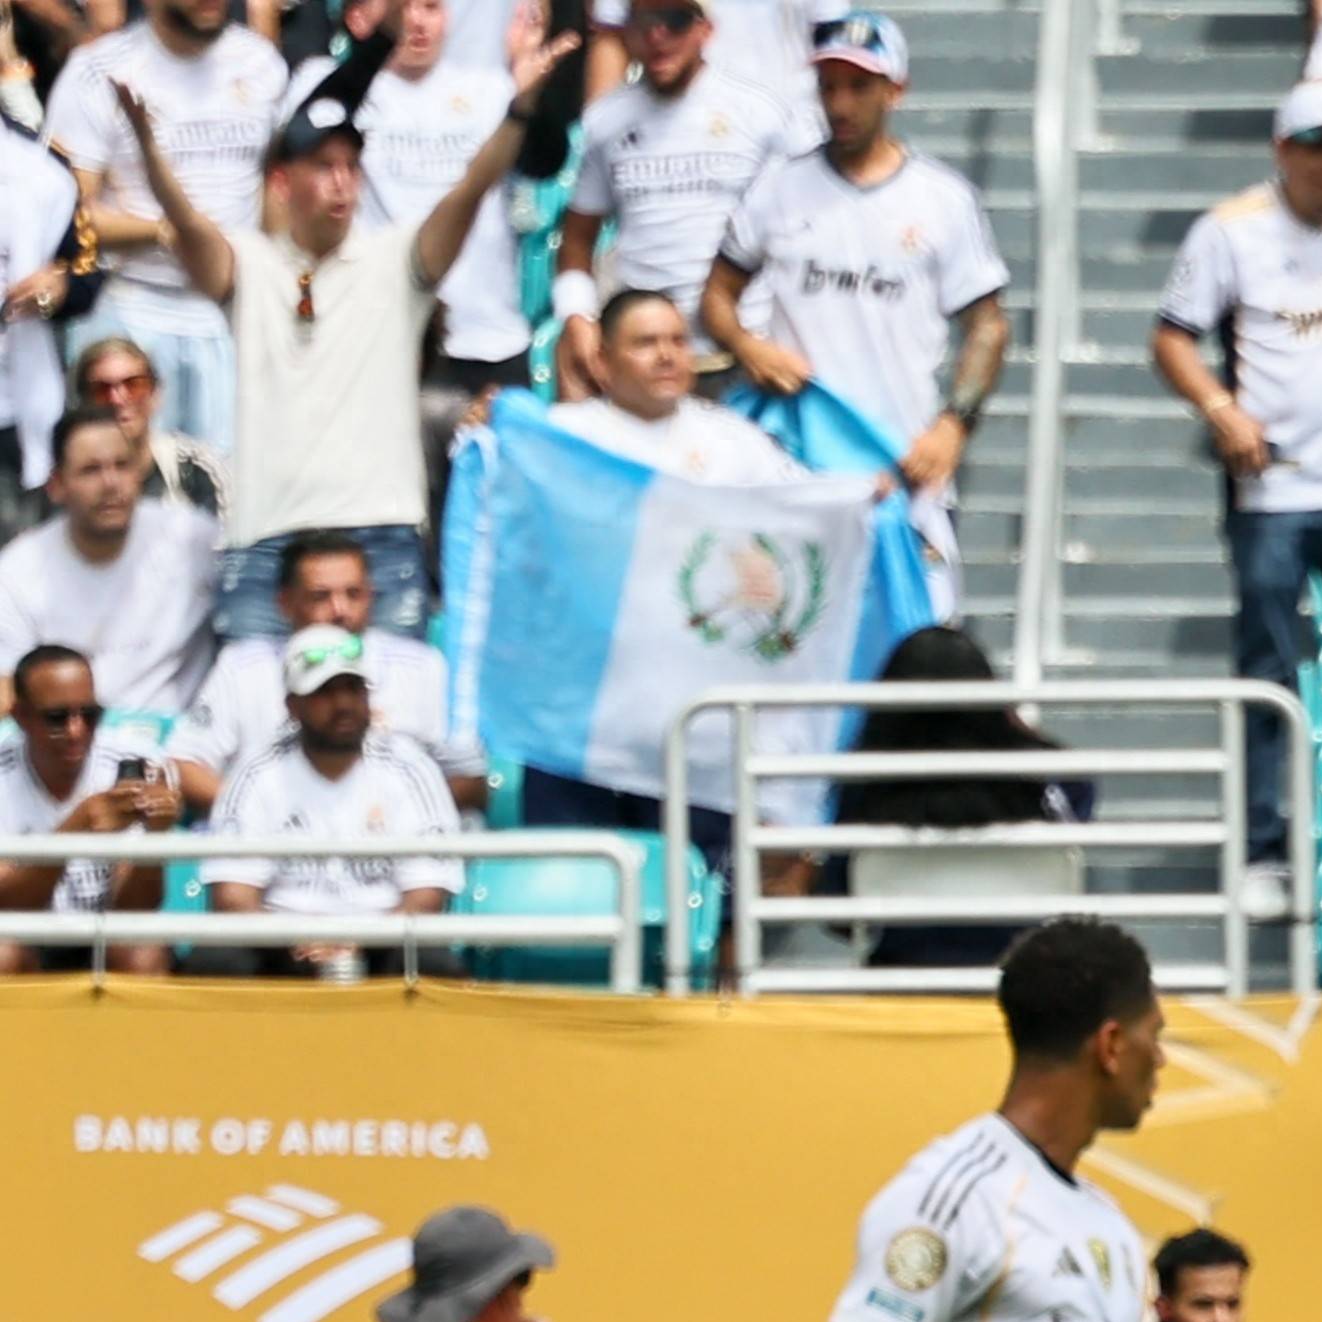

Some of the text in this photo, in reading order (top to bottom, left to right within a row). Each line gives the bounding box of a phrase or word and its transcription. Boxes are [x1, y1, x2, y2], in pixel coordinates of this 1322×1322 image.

[73, 1114, 490, 1160] BANK OF AMERICA
